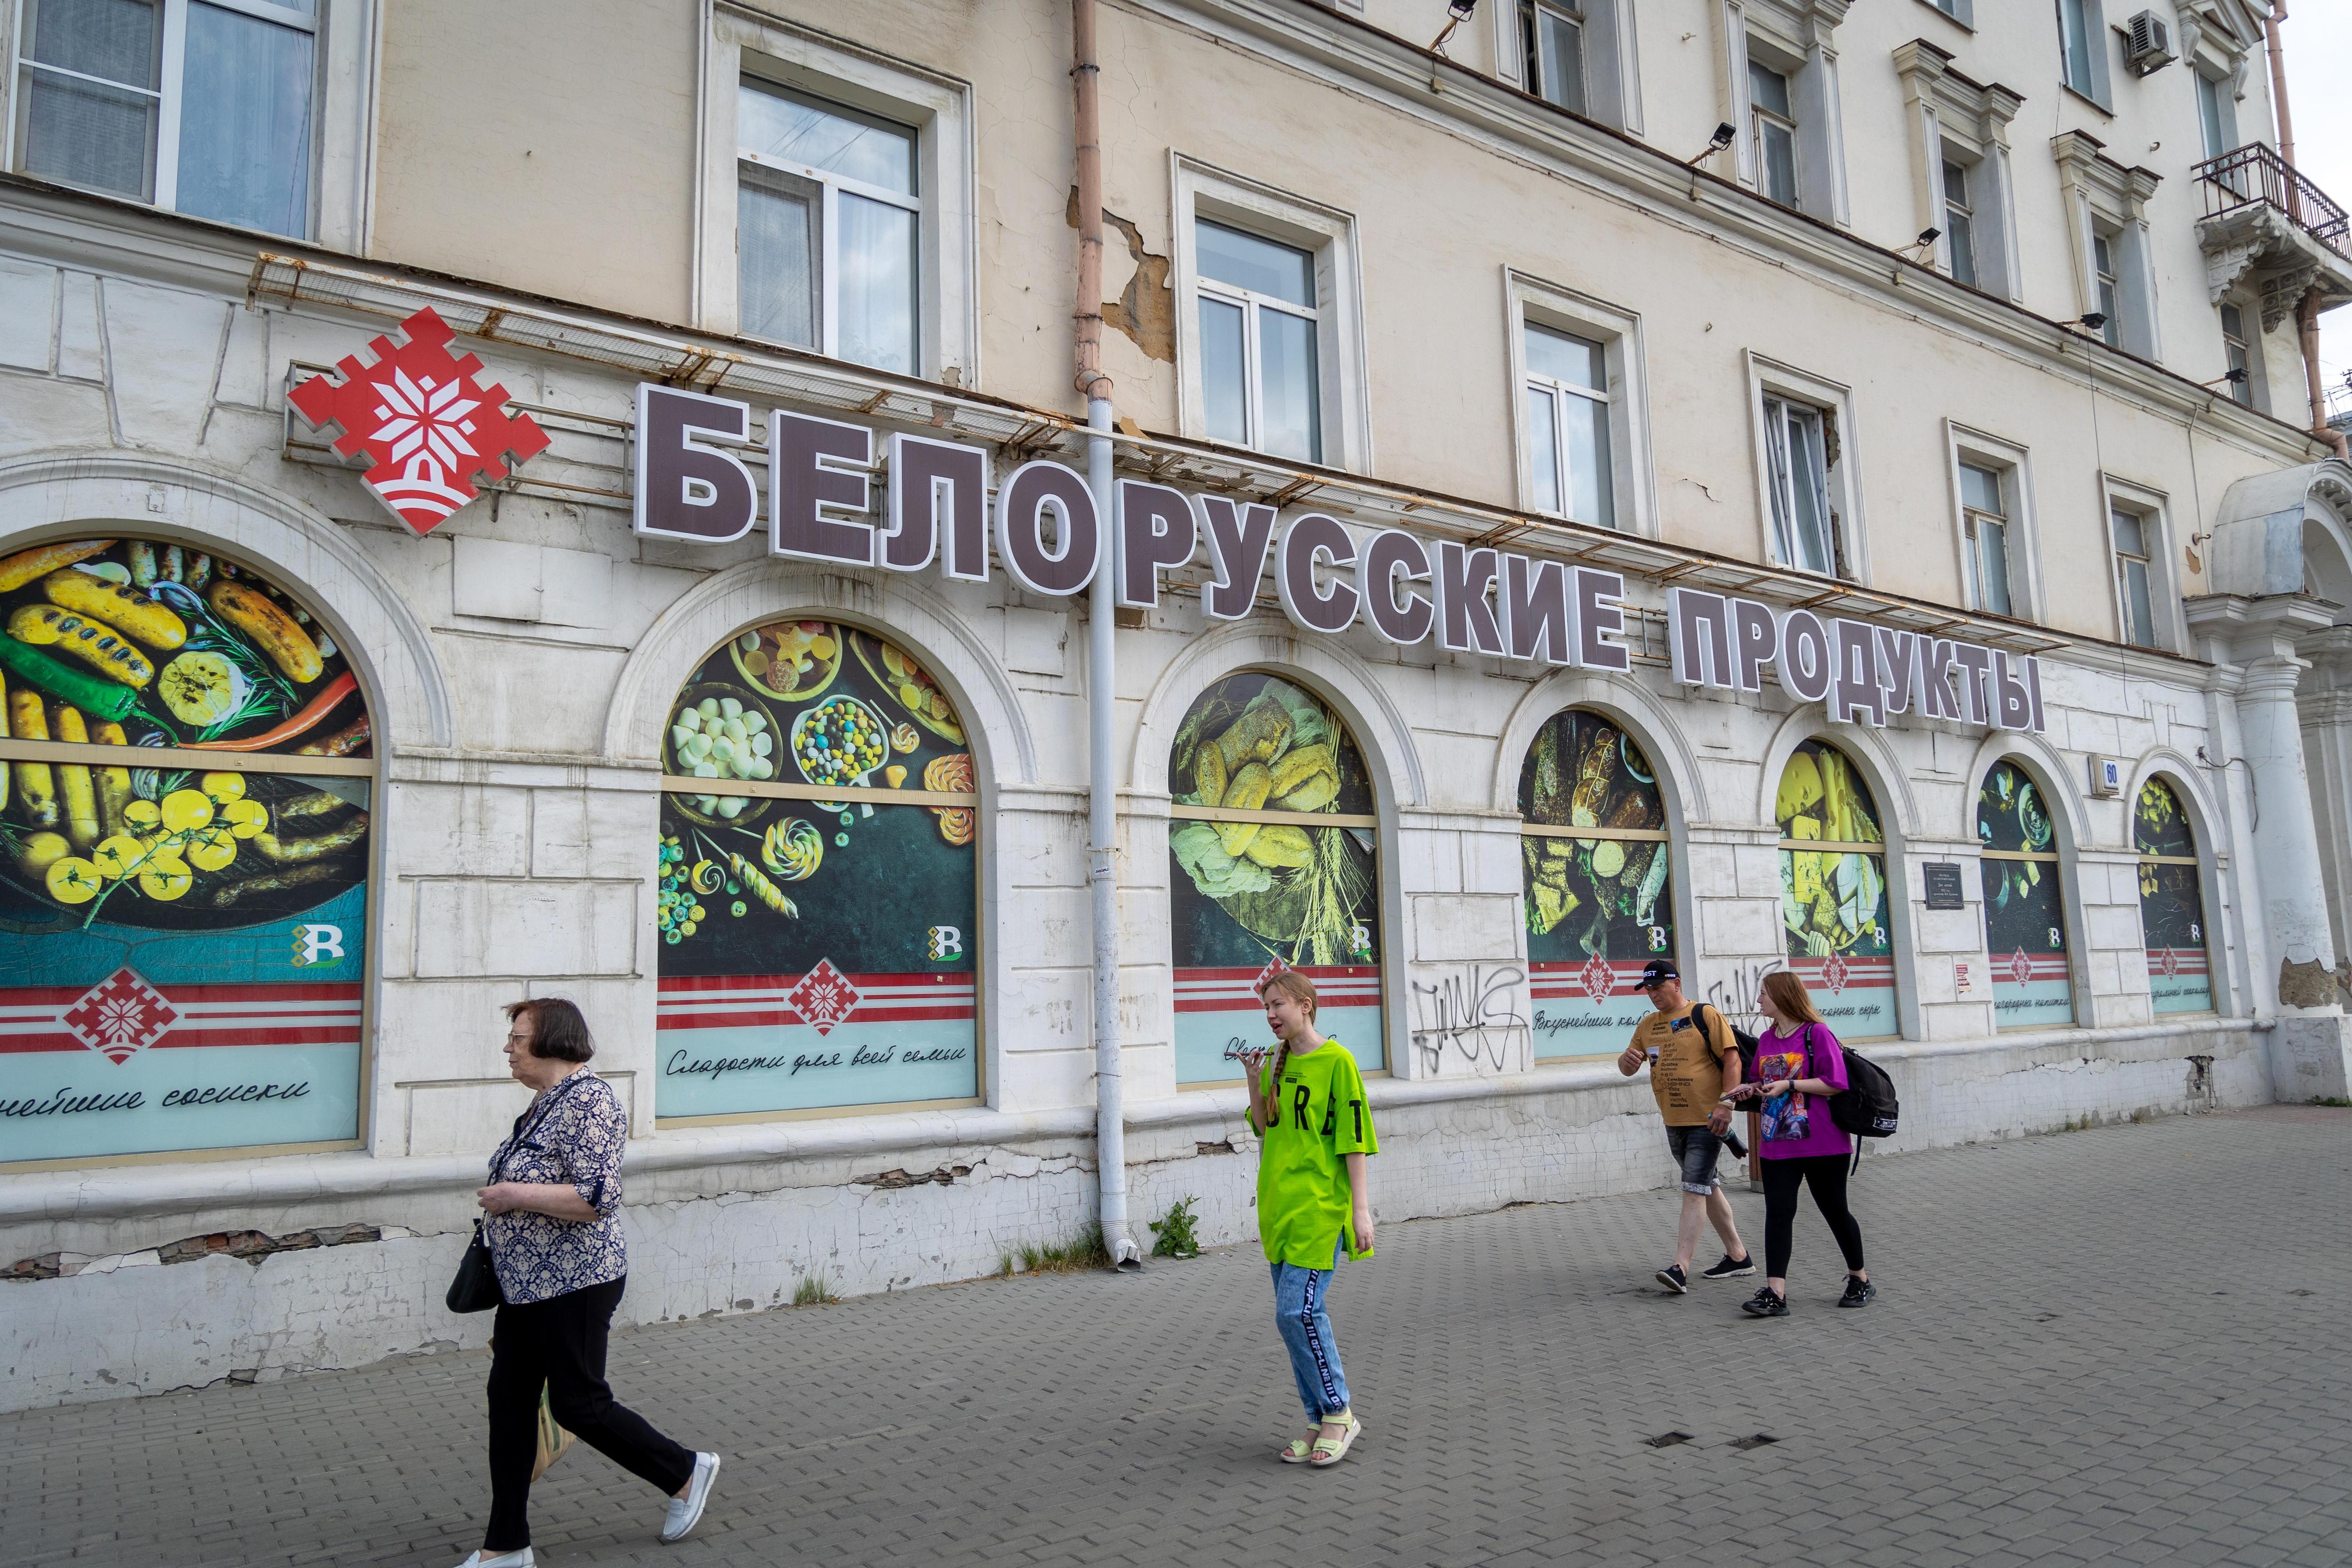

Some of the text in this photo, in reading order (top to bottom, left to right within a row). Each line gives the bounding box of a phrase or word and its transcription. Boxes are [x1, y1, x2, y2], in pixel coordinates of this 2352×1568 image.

[633, 382, 2047, 735] БЕЛОРУССКИЕ ПРОДУКТЫ
[2106, 764, 2117, 784] 60
[1818, 1004, 1881, 1021] сканные сыры
[2035, 998, 2070, 1008] напитки
[1532, 1010, 1614, 1037] Вкуснейшие
[666, 1044, 967, 1080] Сладости для всей семьи
[161, 1081, 310, 1107] сосиски
[1311, 1338, 1331, 1382] OFF-LINE
